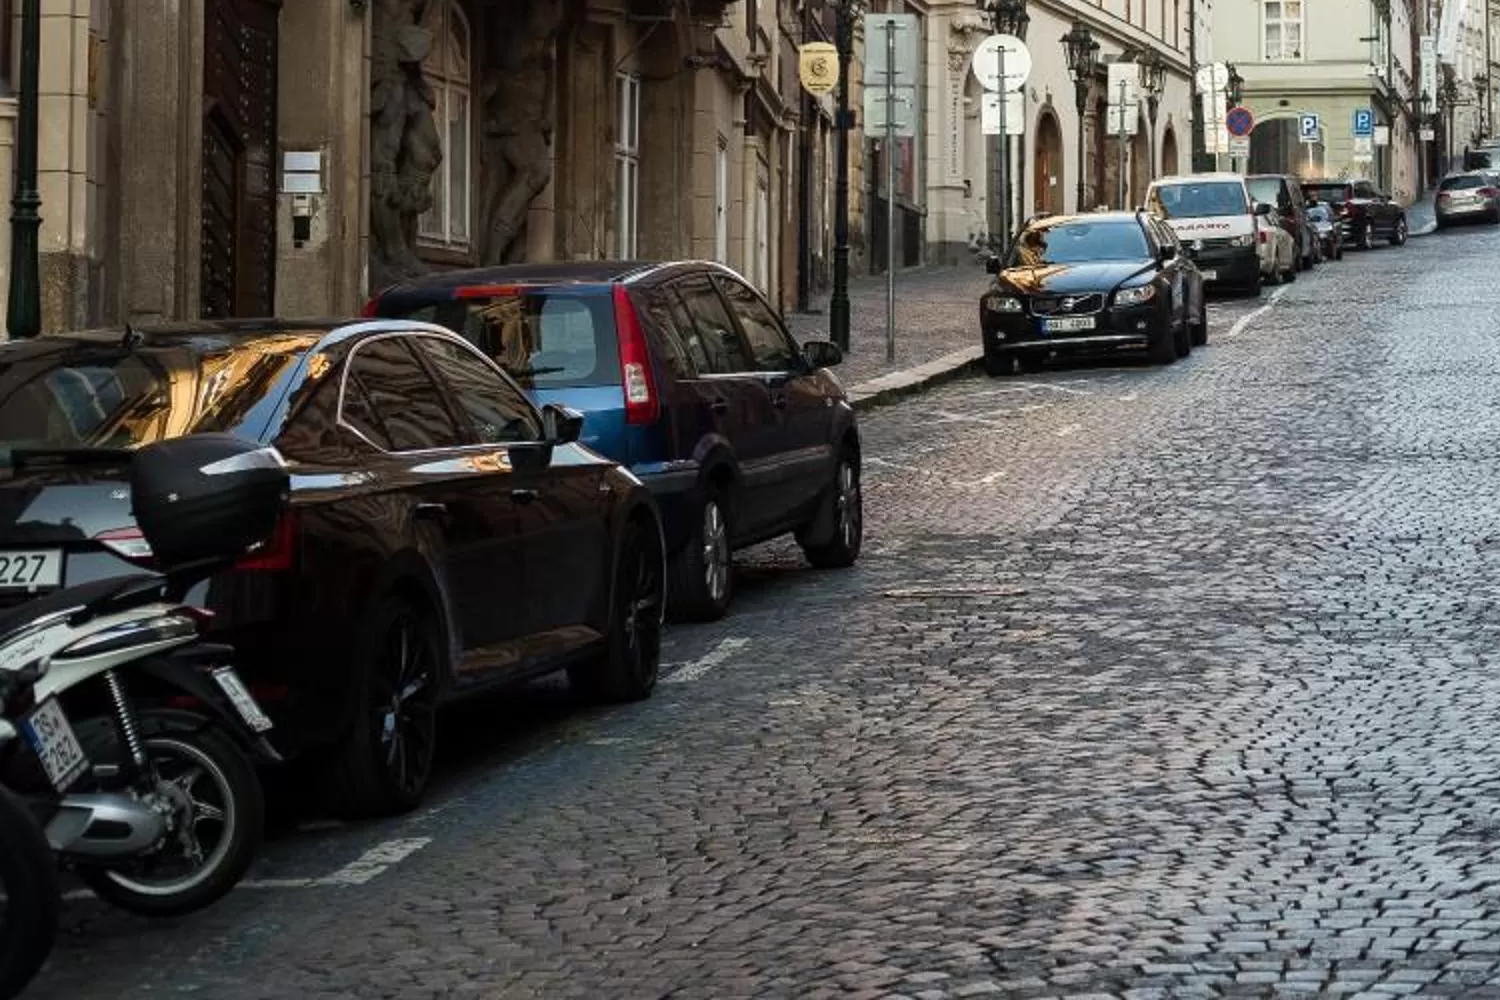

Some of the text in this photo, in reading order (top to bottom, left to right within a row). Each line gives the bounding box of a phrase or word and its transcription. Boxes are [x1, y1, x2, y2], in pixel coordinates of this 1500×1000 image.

[1303, 117, 1315, 135] P
[1358, 113, 1369, 129] P
[0, 555, 46, 583] 227
